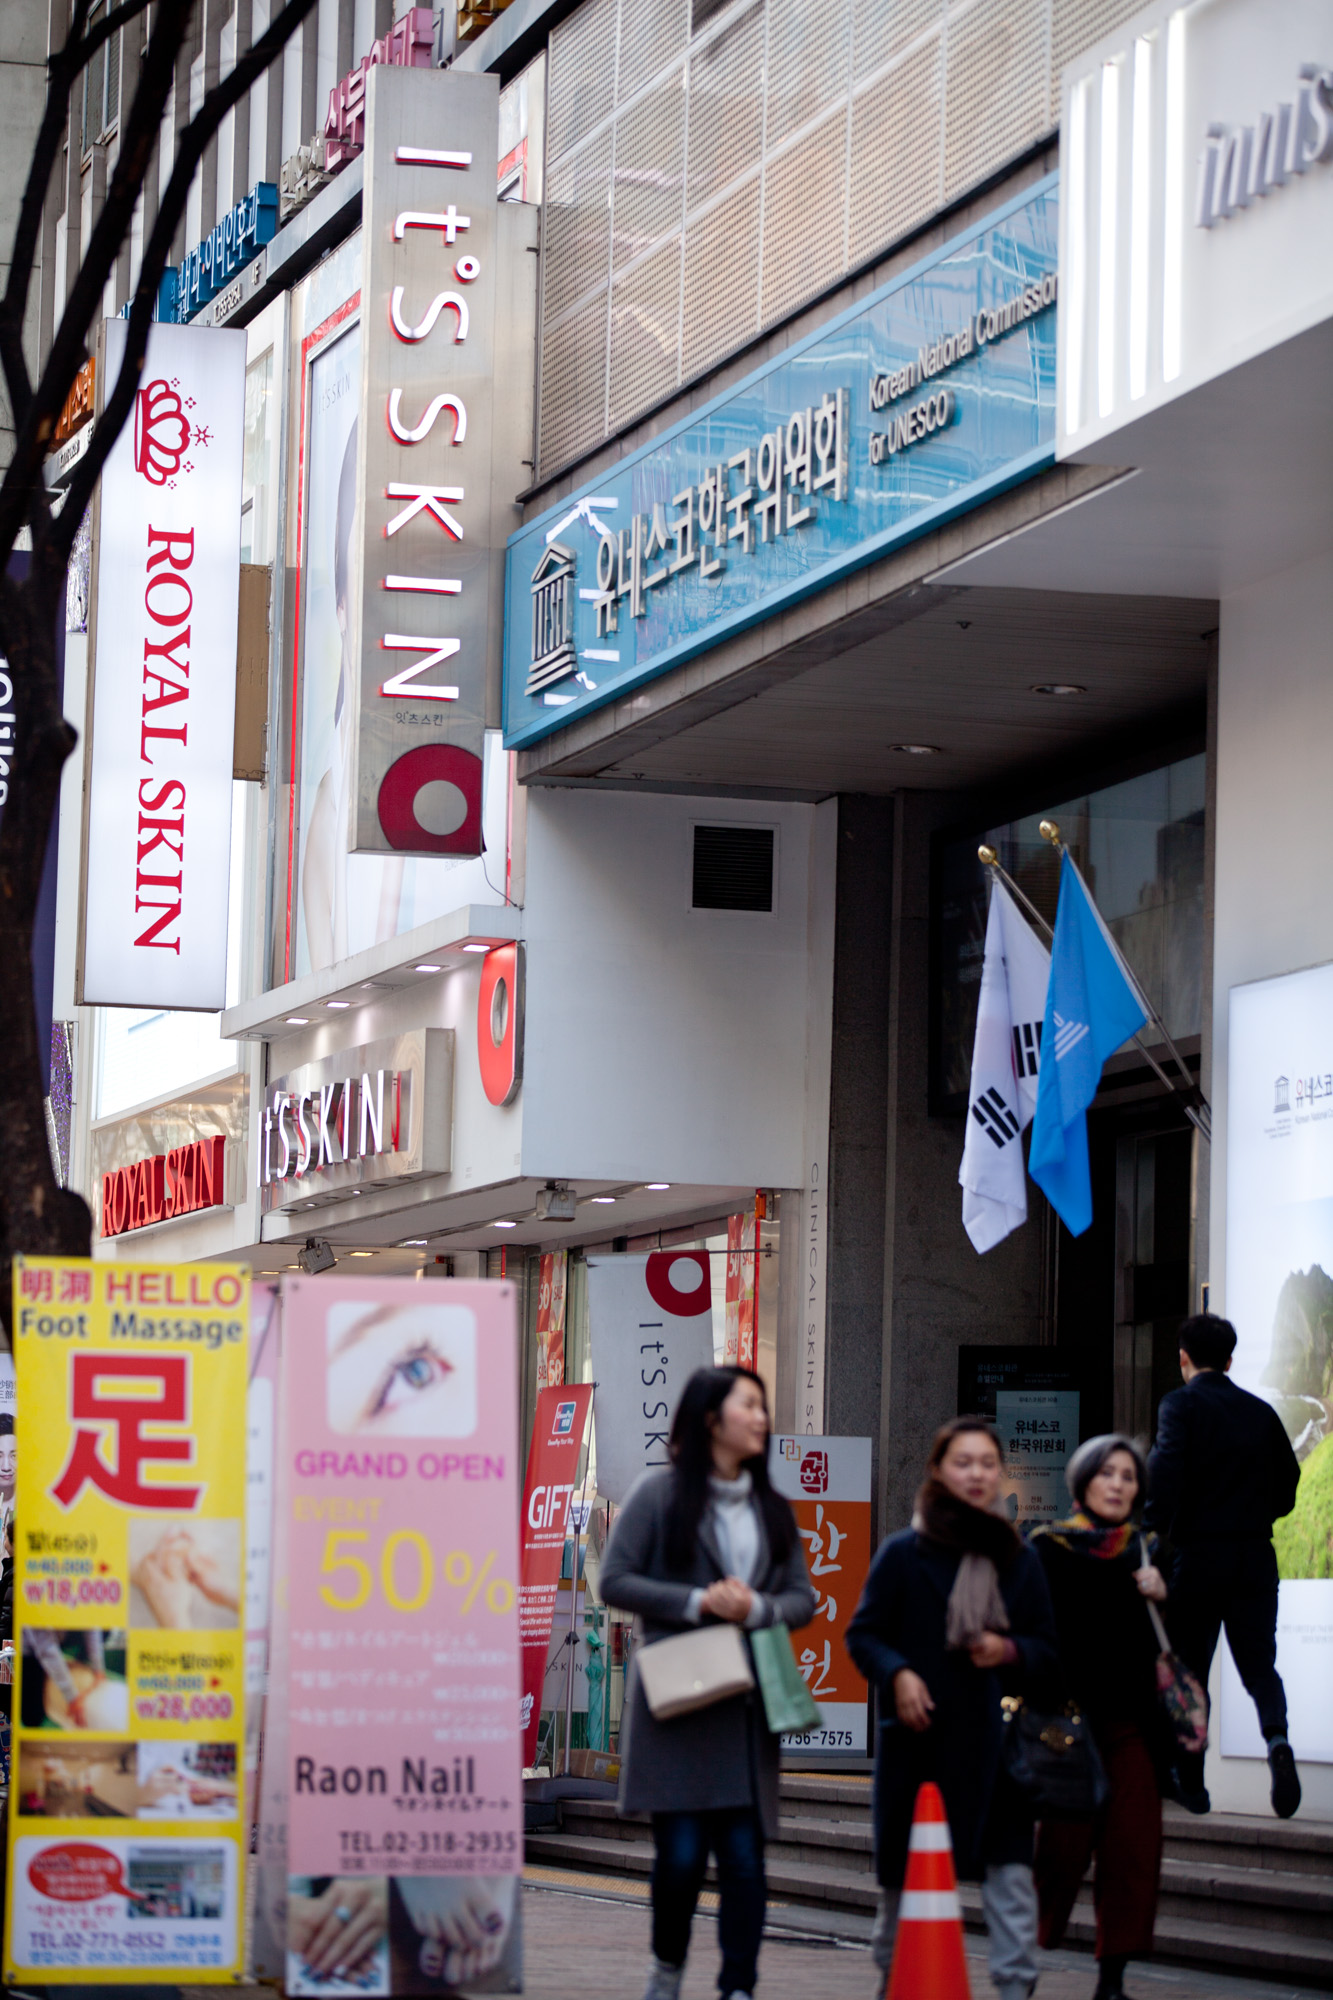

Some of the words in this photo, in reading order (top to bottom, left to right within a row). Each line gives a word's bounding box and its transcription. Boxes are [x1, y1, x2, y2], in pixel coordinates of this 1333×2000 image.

[869, 362, 915, 411] Korean
[918, 317, 975, 382] National
[869, 433, 888, 465] for
[888, 390, 953, 453] UNESCO
[140, 523, 194, 765] ROYAL
[133, 776, 187, 956] SKIN
[101, 1155, 165, 1237] ROYAL
[166, 1135, 226, 1219] SKIN
[808, 1162, 819, 1309] CLINICAL
[21, 1269, 92, 1304] 明洞
[106, 1272, 242, 1306] HELLO
[20, 1309, 87, 1337] Foot
[111, 1312, 242, 1349] Massage
[807, 1323, 816, 1389] SKIN
[50, 1352, 204, 1511] 足
[1009, 1439, 1066, 1453] 한국위원회
[1015, 1420, 1060, 1434] 유네스코
[295, 1450, 407, 1480] GRAND
[417, 1453, 505, 1480] OPEN
[294, 1496, 382, 1522] EVENT
[528, 1484, 574, 1529] GIFT
[295, 1755, 388, 1795] Raon
[402, 1755, 475, 1795] Nail
